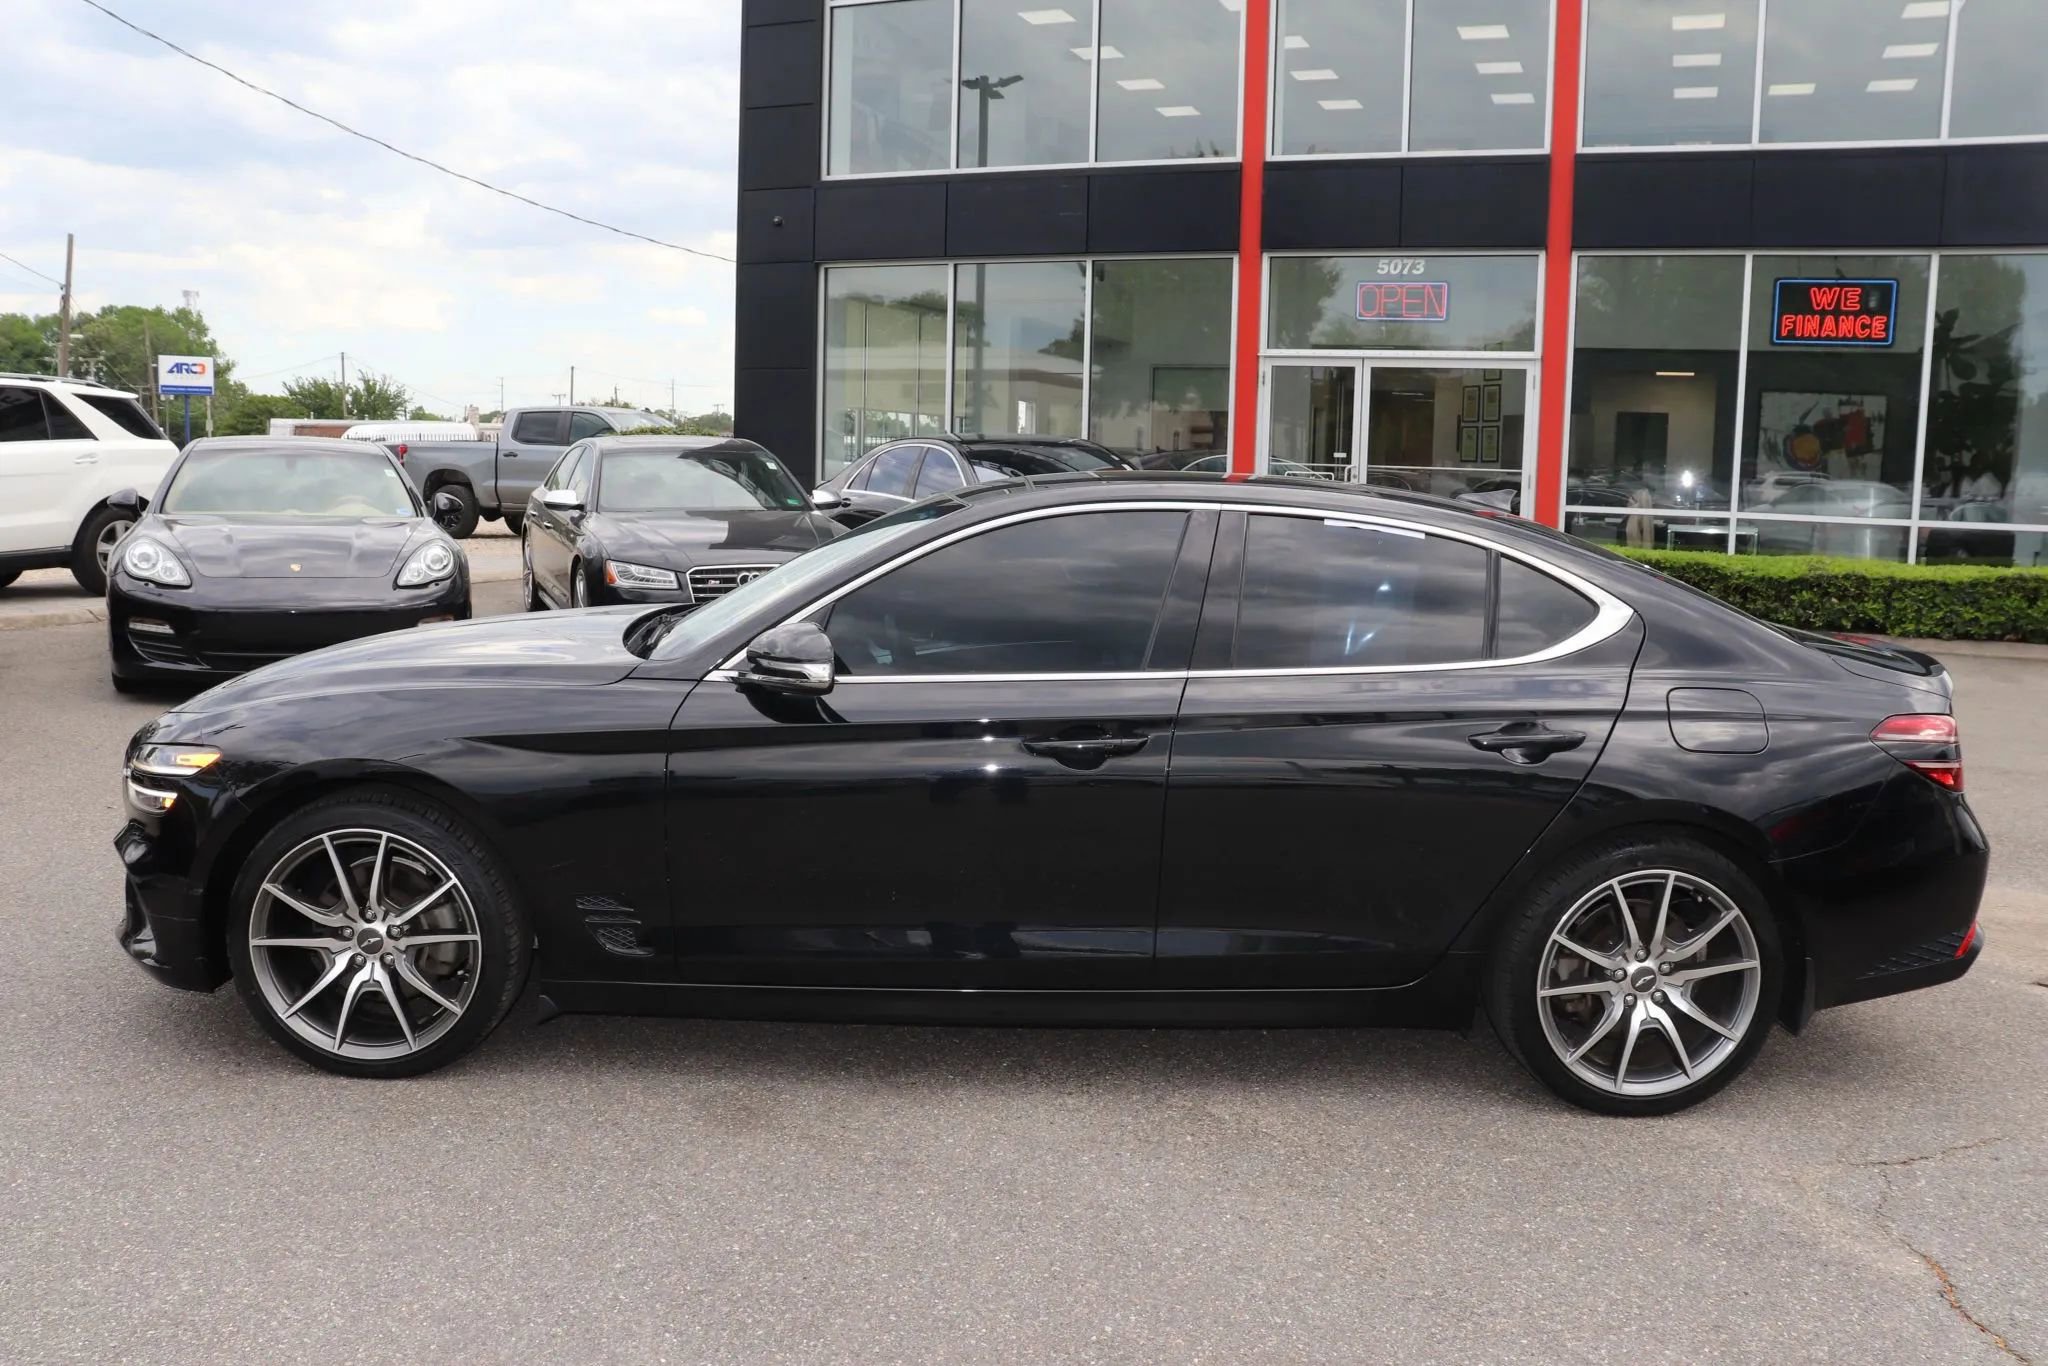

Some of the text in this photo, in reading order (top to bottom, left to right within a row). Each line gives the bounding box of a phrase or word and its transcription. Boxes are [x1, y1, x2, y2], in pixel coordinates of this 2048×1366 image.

[1377, 259, 1425, 275] 5073
[1359, 284, 1446, 317] OPEN
[1810, 287, 1861, 311] WE
[1781, 314, 1888, 339] FINANCE
